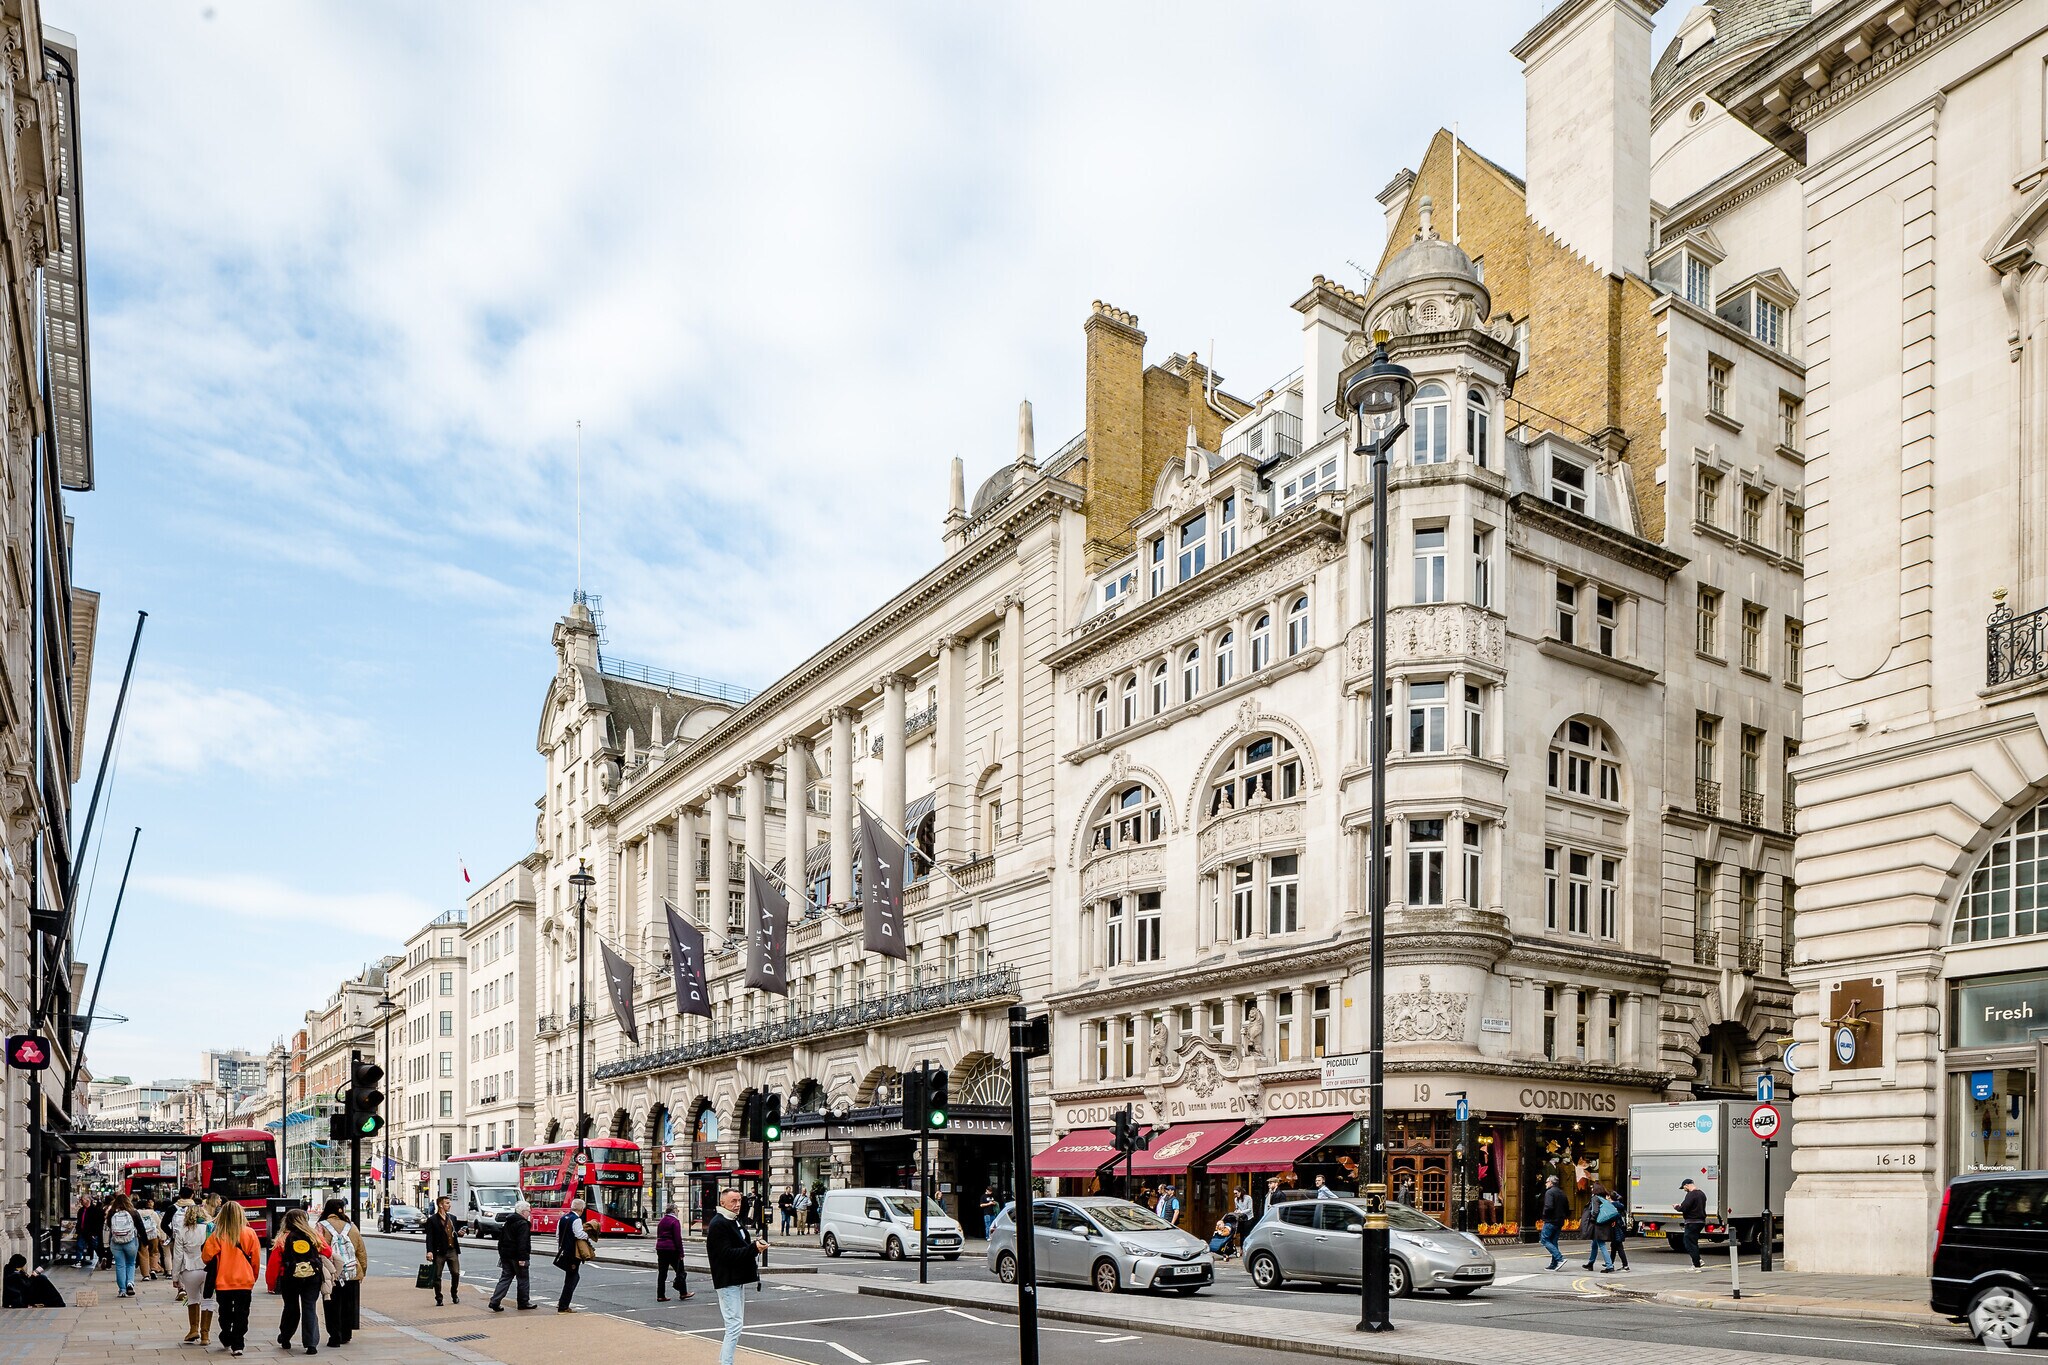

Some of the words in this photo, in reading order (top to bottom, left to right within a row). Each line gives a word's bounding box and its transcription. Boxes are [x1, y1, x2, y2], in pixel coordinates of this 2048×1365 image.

[762, 903, 774, 975] DILLY
[1984, 1001, 2033, 1021] Fresh
[1326, 1058, 1358, 1067] PICCADILLY
[1268, 1088, 1371, 1111] CORDING
[1413, 1084, 1430, 1102] 19
[1171, 1101, 1186, 1116] 20
[1229, 1096, 1246, 1113] 20
[1519, 1088, 1616, 1112] CORDINGS
[1066, 1104, 1145, 1124] CORDIS
[72, 1114, 185, 1130] Waterstones
[868, 1123, 883, 1132] THE
[947, 1120, 961, 1129] HE
[967, 1120, 1006, 1130] DILLY
[1668, 1121, 1682, 1131] get
[1683, 1120, 1696, 1129] set
[1697, 1118, 1712, 1128] hire
[1732, 1116, 1744, 1129] get
[782, 1129, 794, 1137] THE
[1244, 1133, 1324, 1145] CORDINGS
[1057, 1145, 1113, 1153] CORDINGS
[626, 1172, 635, 1180] 38
